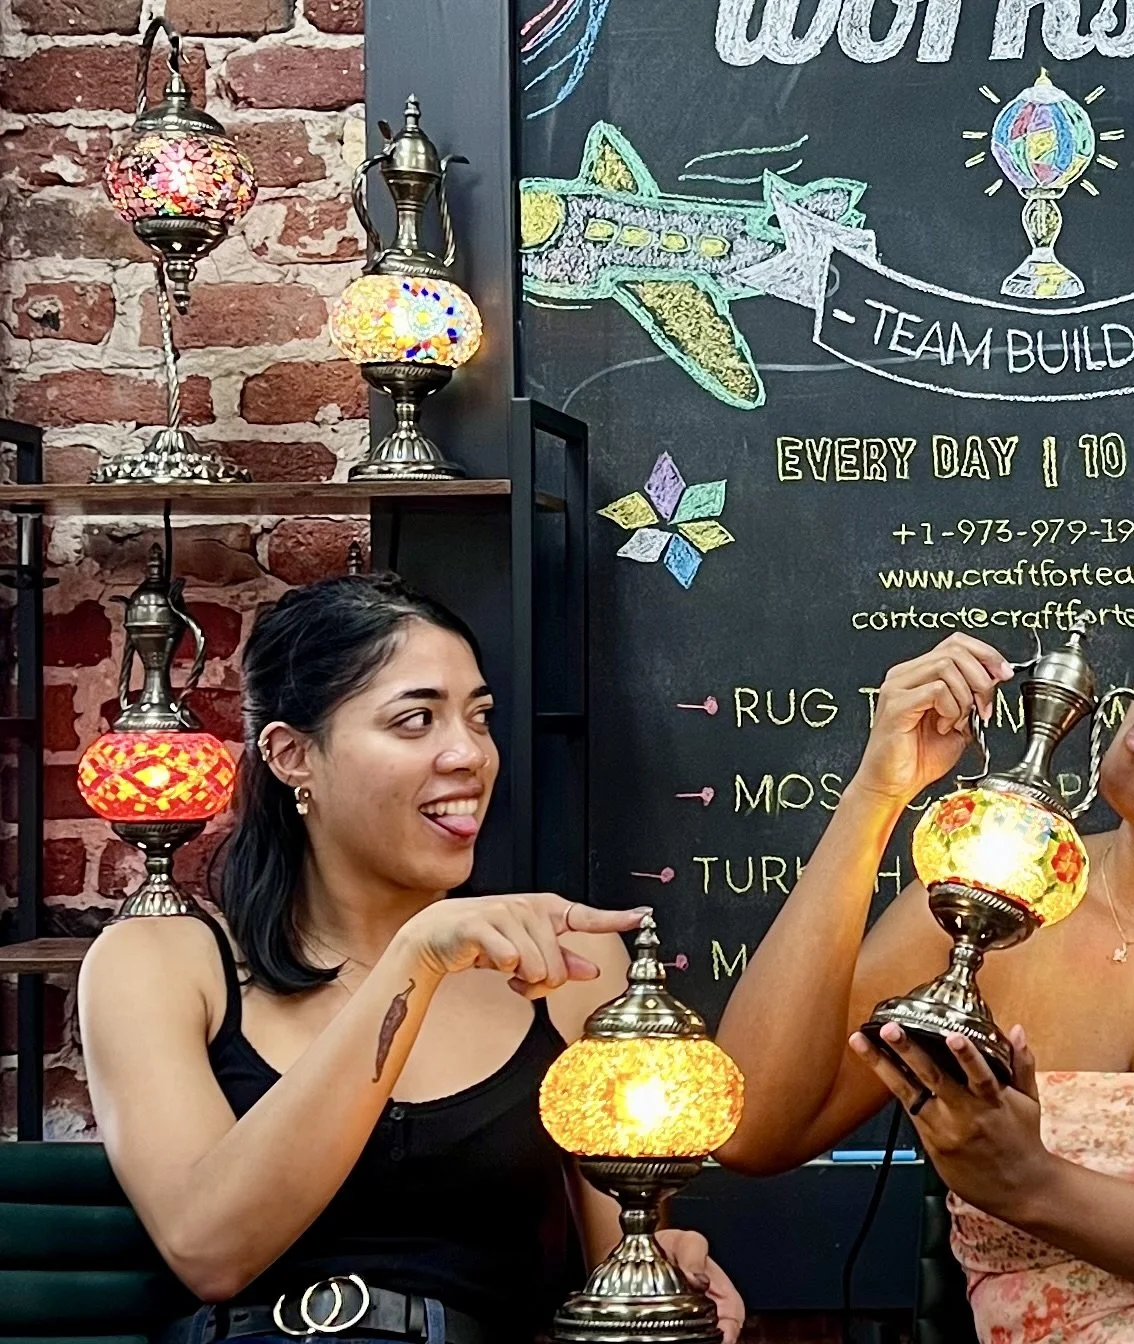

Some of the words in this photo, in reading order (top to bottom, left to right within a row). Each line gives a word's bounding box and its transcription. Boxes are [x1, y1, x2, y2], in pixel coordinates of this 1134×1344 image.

[864, 297, 993, 372] TEAM
[776, 436, 918, 483] EVERY
[932, 435, 1019, 480] DAY
[1080, 433, 1128, 479] 10
[734, 686, 839, 729] RUG
